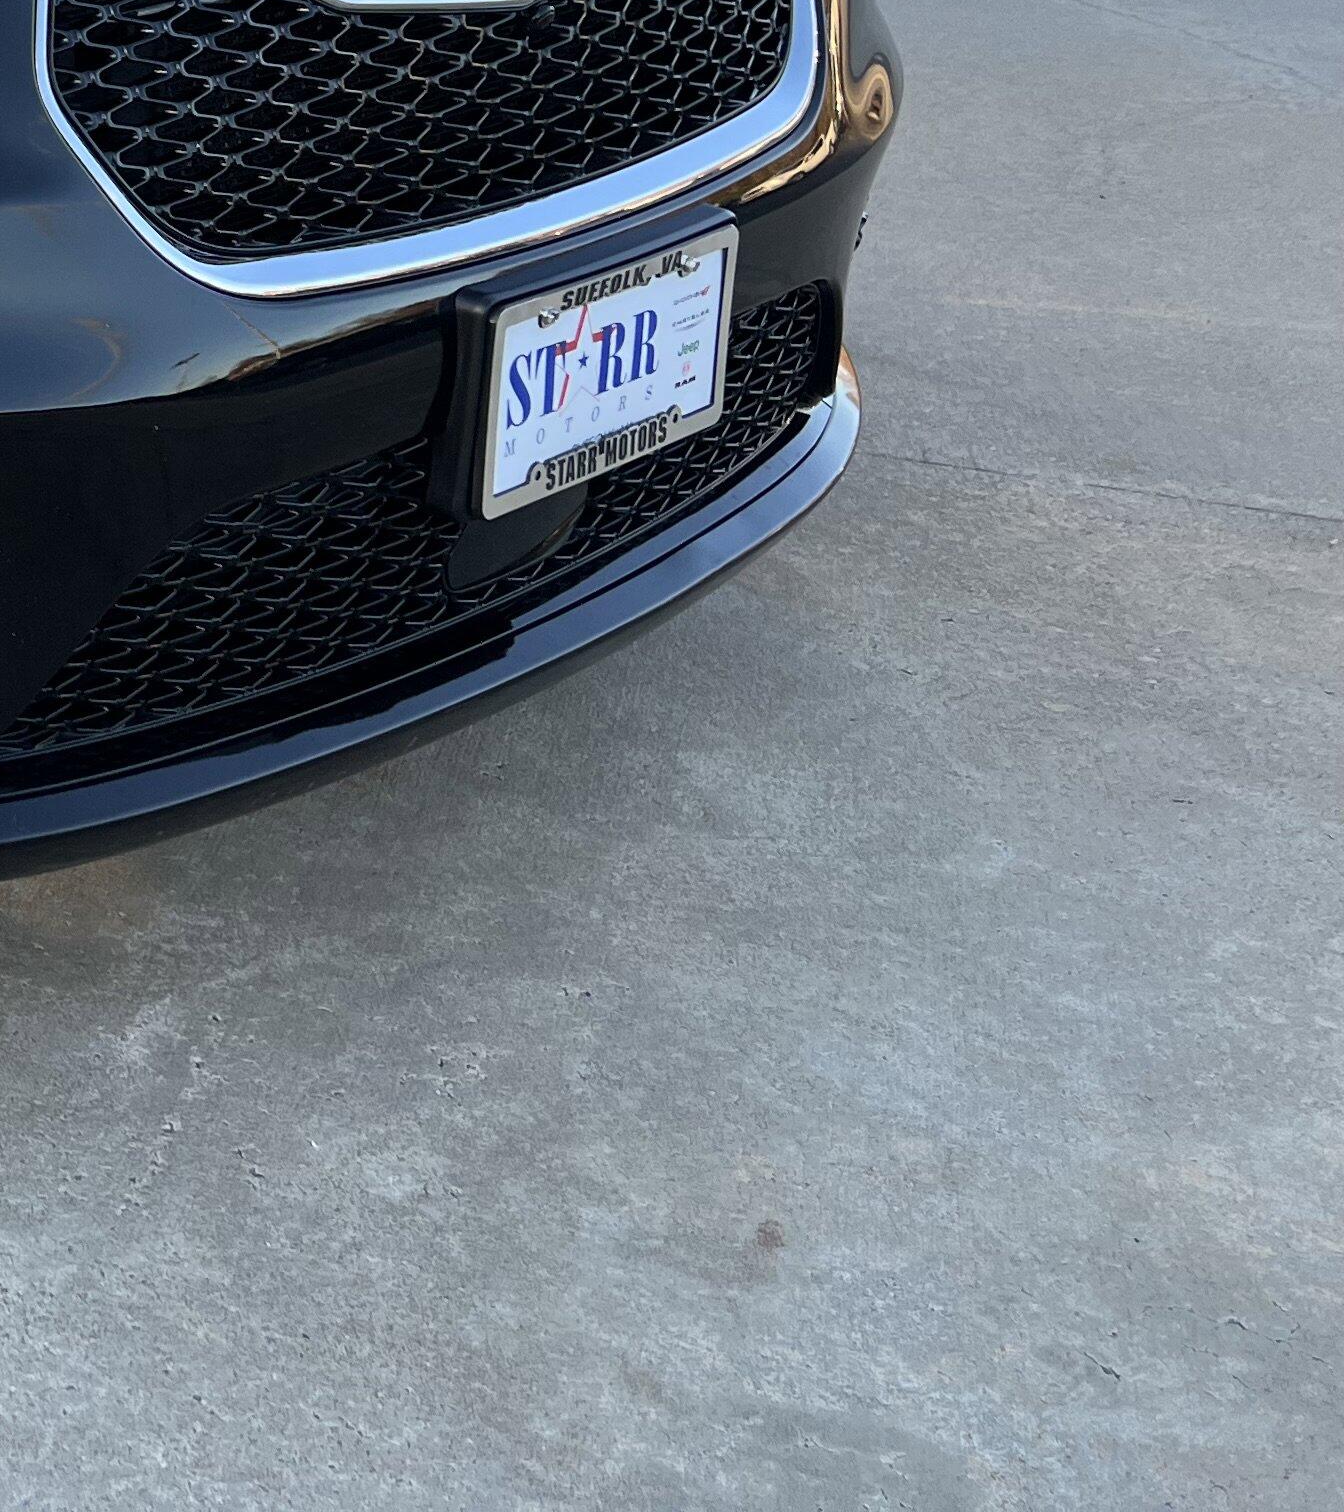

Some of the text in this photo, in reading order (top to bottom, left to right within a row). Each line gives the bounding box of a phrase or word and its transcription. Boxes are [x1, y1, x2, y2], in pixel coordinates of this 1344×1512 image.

[676, 339, 700, 357] Jeep
[674, 375, 697, 389] RAM
[545, 445, 597, 490] STARR
[604, 416, 668, 468] MOTORS
